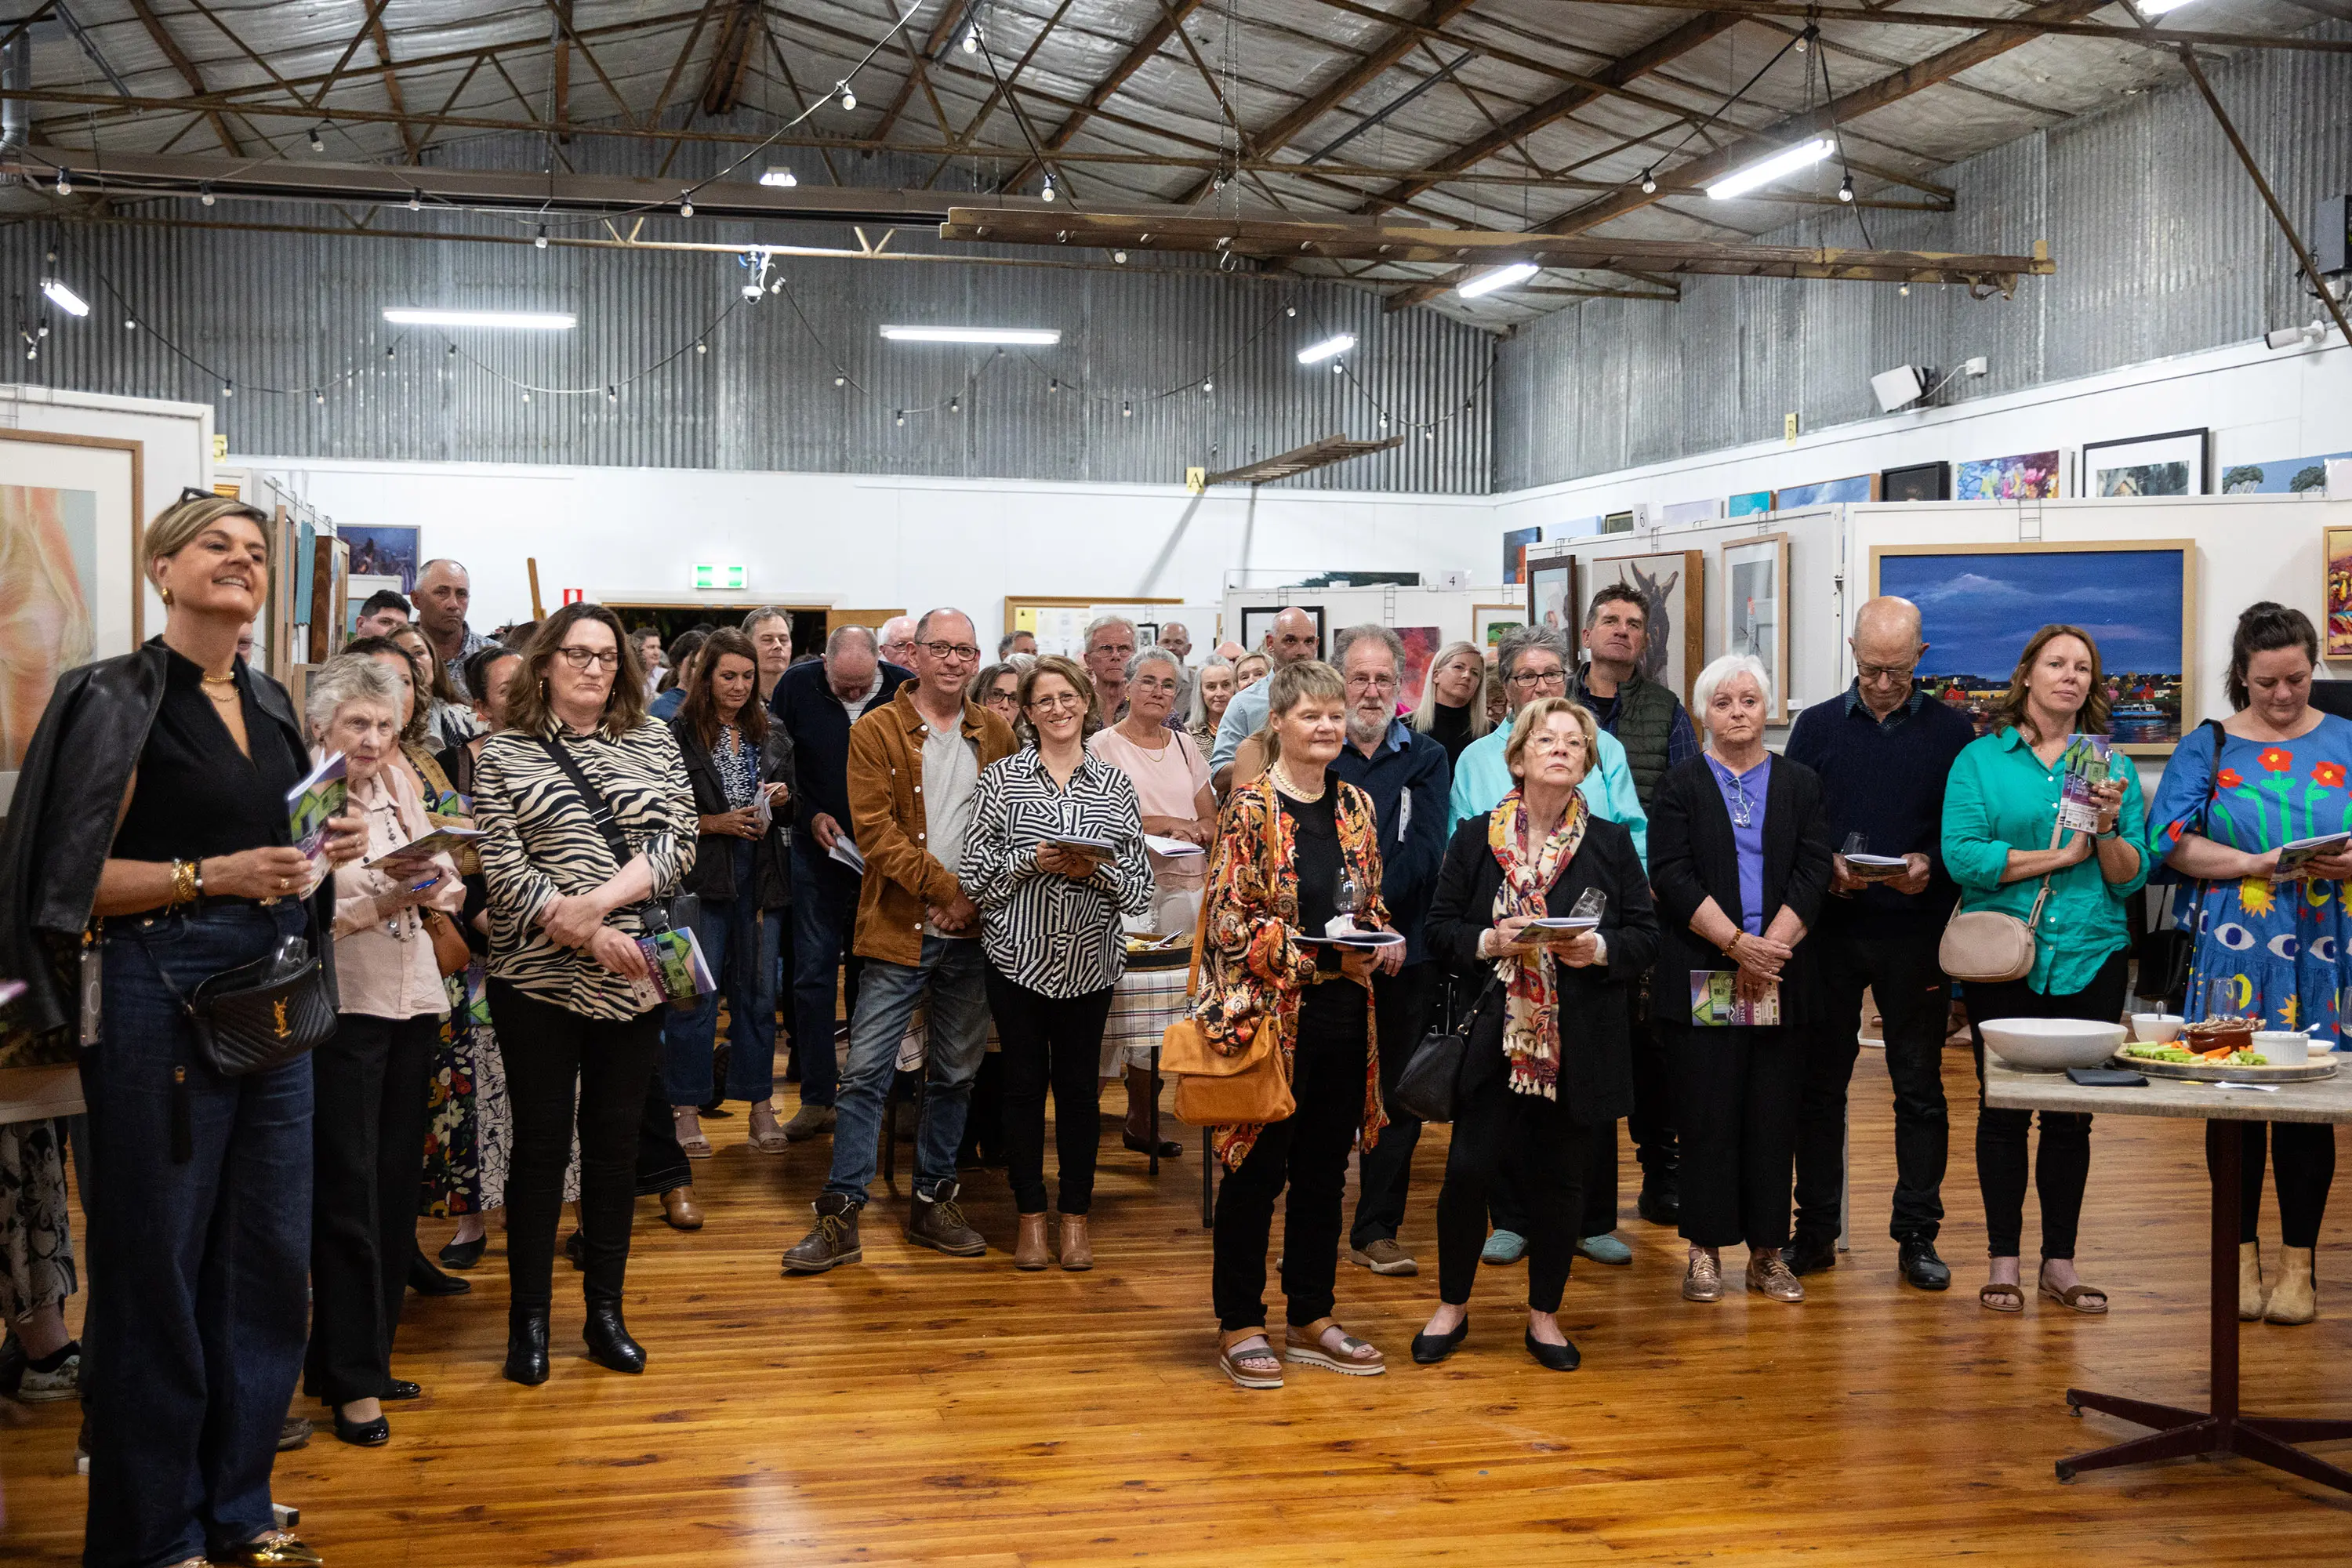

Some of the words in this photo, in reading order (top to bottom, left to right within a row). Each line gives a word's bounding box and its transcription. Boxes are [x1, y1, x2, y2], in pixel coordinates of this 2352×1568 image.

[1788, 420, 1794, 440] B
[1189, 473, 1202, 488] A
[1639, 511, 1645, 527] 6
[1449, 576, 1455, 586] 4
[657, 975, 671, 994] SHOW
